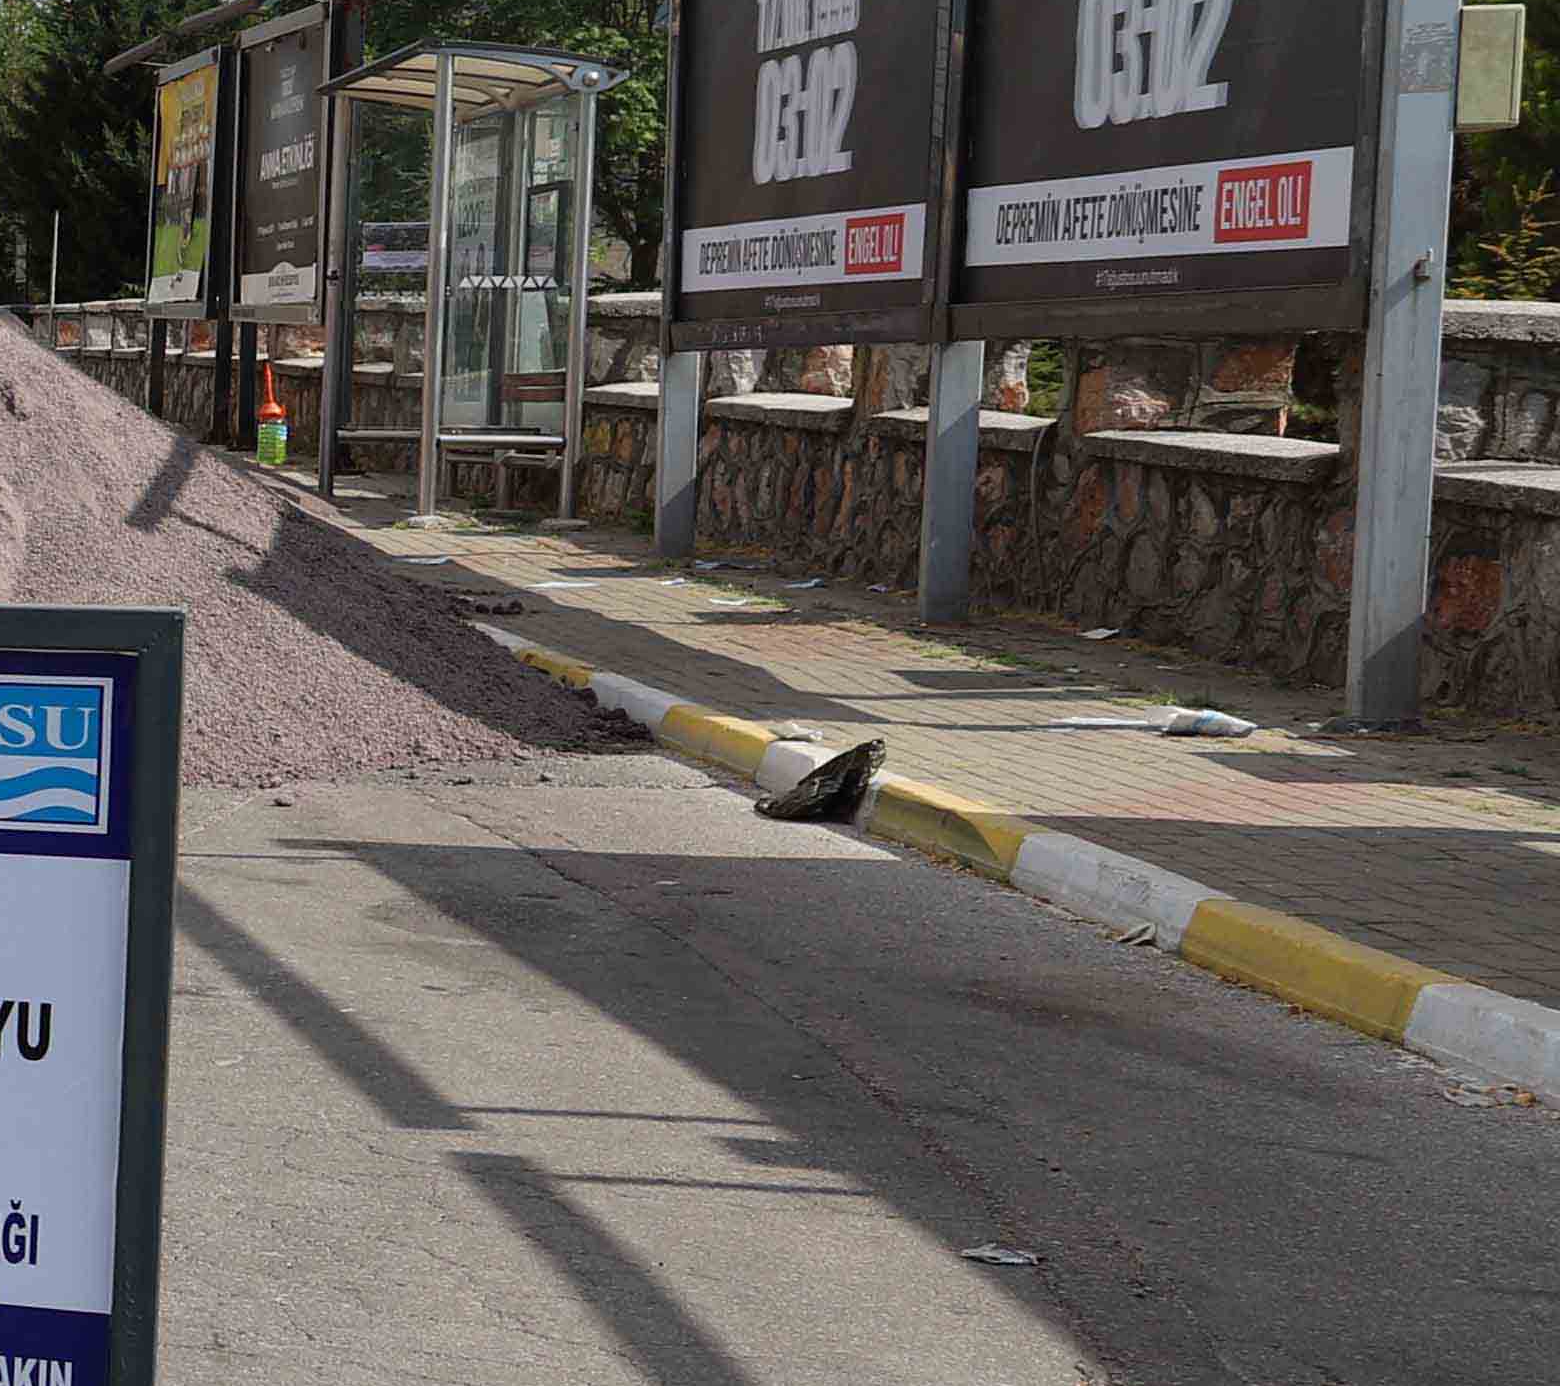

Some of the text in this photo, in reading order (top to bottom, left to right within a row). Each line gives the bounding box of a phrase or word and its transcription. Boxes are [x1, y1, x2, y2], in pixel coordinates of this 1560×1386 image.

[996, 175, 1305, 245] DEPREMİN AFETE DÖNÜŞMESİNE ENGEL OL!
[848, 225, 879, 266] ENGEL
